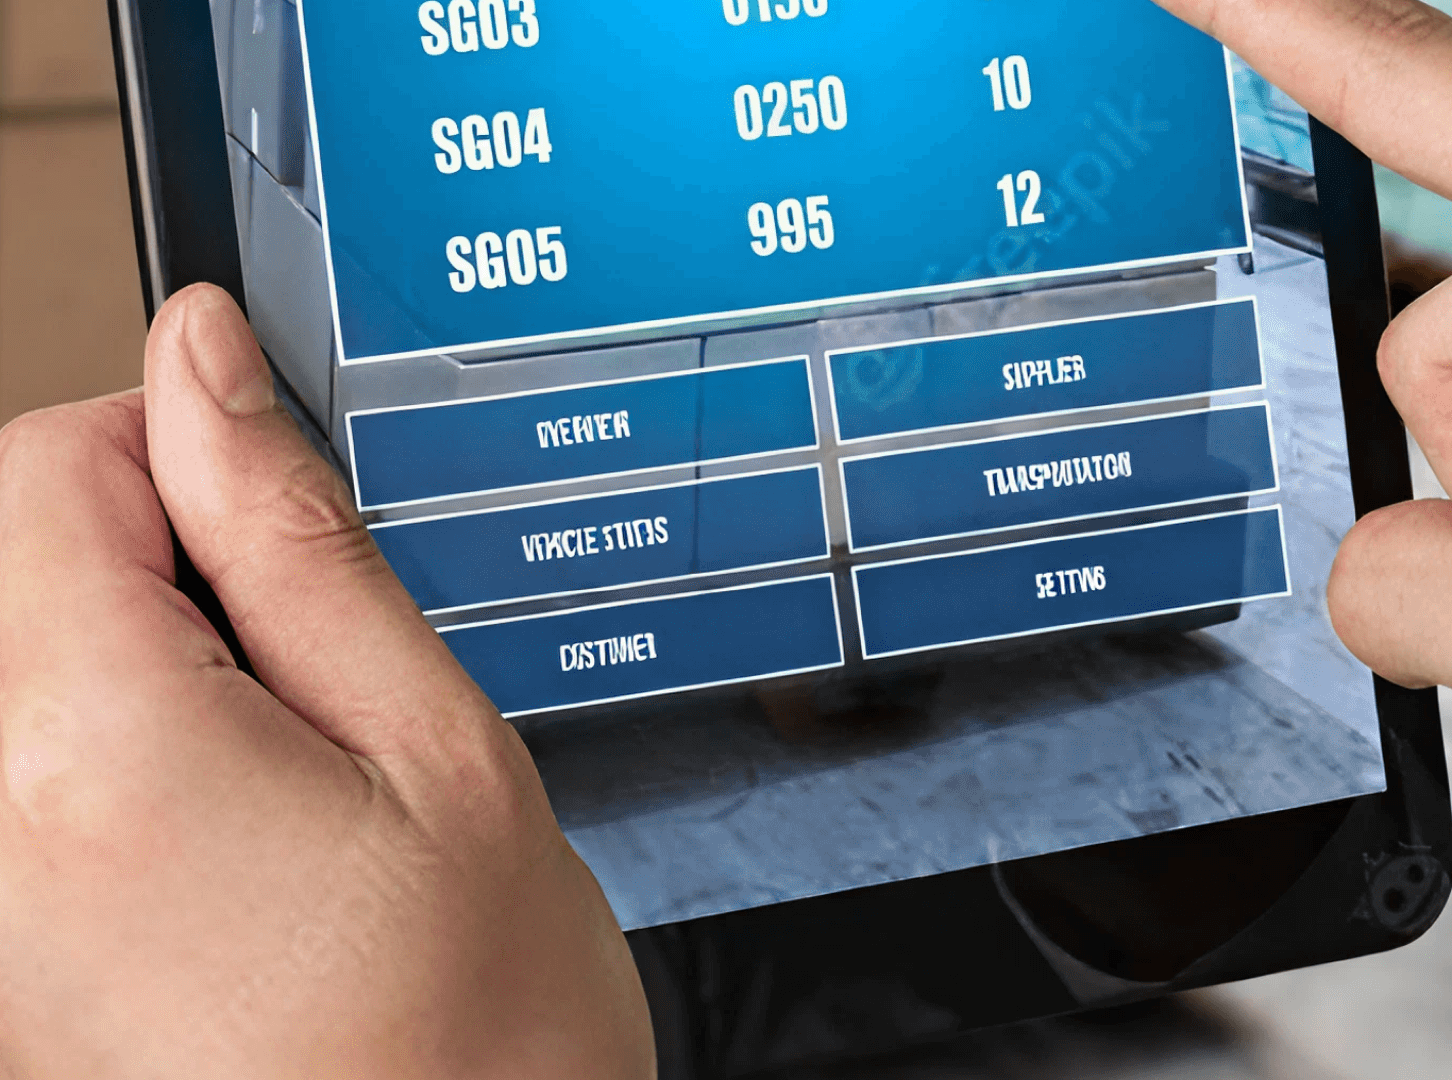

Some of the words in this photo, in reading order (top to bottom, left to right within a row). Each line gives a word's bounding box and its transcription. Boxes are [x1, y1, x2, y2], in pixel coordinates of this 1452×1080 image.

[431, 107, 553, 174] SG04
[733, 75, 848, 141] 0250
[982, 55, 1032, 111] 10
[446, 226, 568, 293] SG05
[747, 195, 834, 257] 995
[996, 169, 1045, 227] 12
